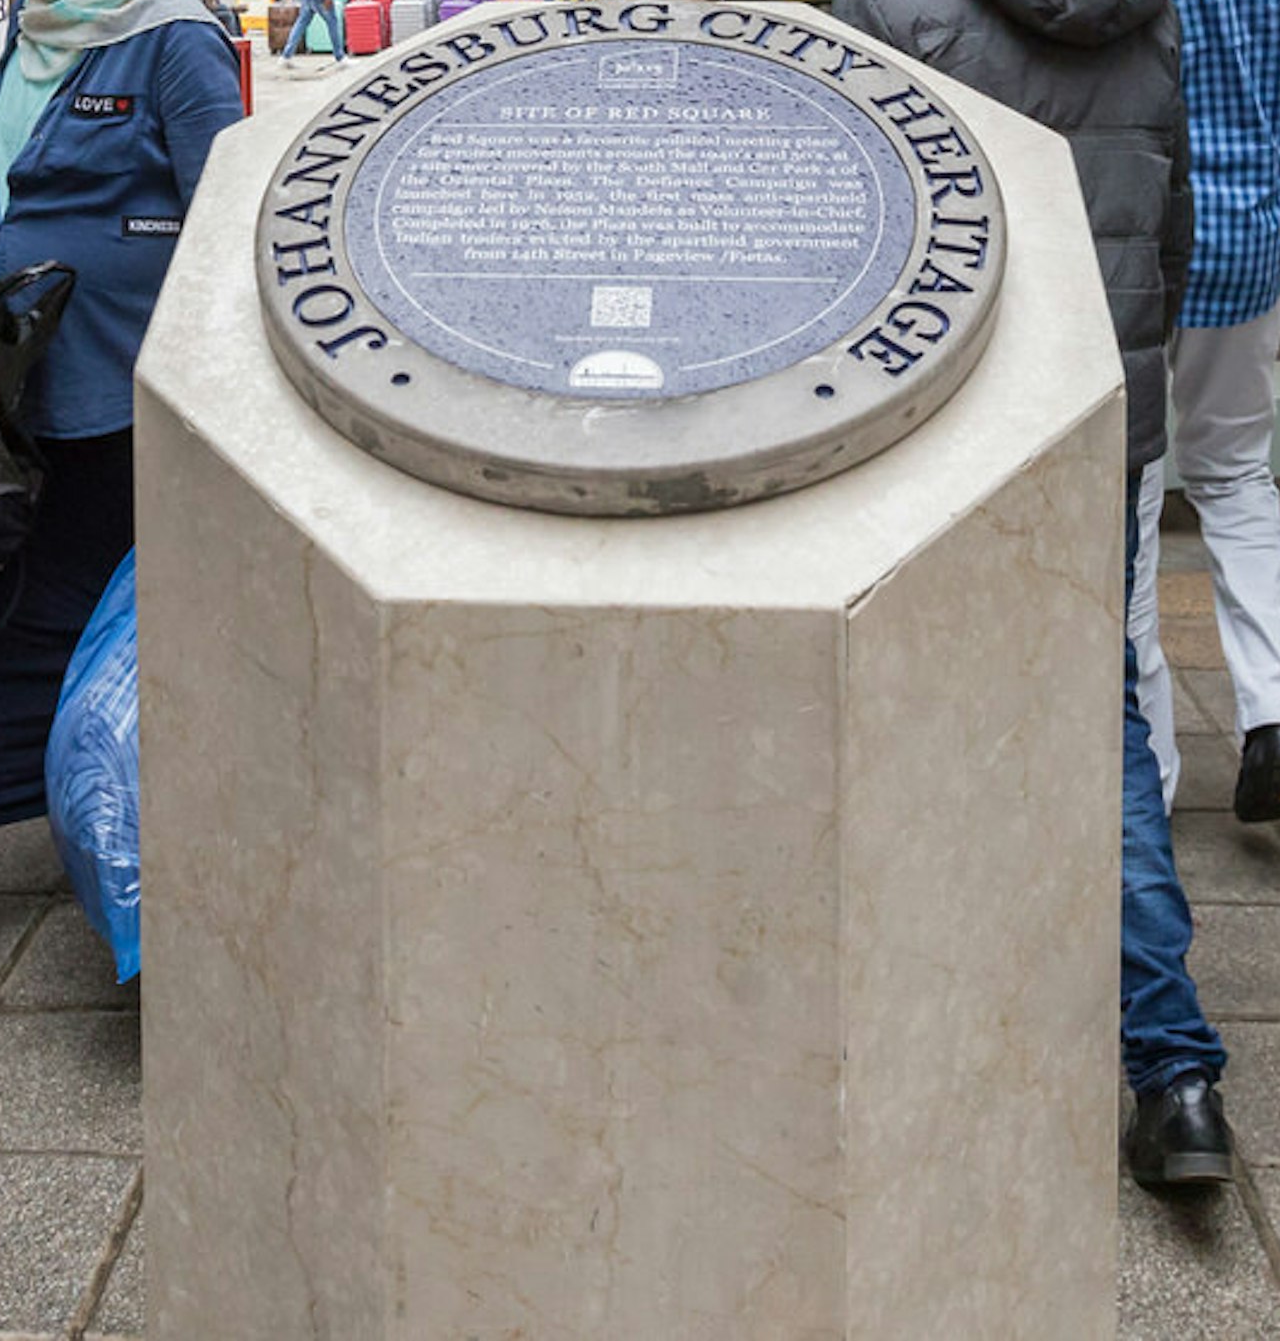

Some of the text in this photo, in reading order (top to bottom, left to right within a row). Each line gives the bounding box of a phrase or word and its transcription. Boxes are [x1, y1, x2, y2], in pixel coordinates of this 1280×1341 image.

[74, 96, 114, 112] LOVE
[499, 106, 771, 122] SITE OF RED SQUARE
[430, 134, 463, 144] Red
[467, 135, 524, 147] Square
[528, 137, 558, 145] was
[577, 135, 650, 145] favourite
[655, 136, 720, 148] political
[725, 136, 792, 148] meeting
[796, 137, 839, 149] place
[417, 148, 441, 158] for
[444, 148, 502, 160] protest
[506, 149, 600, 159] movements
[605, 149, 664, 159] around
[668, 150, 695, 160] the
[755, 150, 787, 160] and
[833, 151, 848, 161] at
[562, 162, 583, 174] by
[586, 162, 613, 172] the
[617, 163, 666, 173] South
[670, 163, 709, 173] Mall
[712, 163, 744, 173] and
[783, 164, 822, 174] Park
[840, 164, 859, 174] of
[400, 174, 428, 184] the
[439, 175, 514, 185] Oriental
[589, 176, 624, 186] The
[636, 176, 714, 186] Defiance
[725, 177, 817, 189] Campaign
[828, 180, 864, 188] was
[273, 2, 990, 379] JOHANNESBURG CITY HERITAGE
[395, 189, 471, 199] launched
[481, 190, 519, 200] here
[528, 190, 545, 200] in
[610, 191, 637, 201] the
[646, 191, 680, 201] first
[691, 194, 734, 202] mass
[743, 193, 867, 205] anti-apartheid
[391, 203, 475, 216] campaign
[478, 204, 505, 215] led
[509, 204, 531, 217] by
[535, 204, 593, 215] Nelson
[598, 205, 673, 216] Mandela
[677, 207, 696, 216] as
[392, 218, 487, 231] Completed
[490, 219, 507, 230] in
[559, 219, 588, 230] the
[593, 220, 637, 231] Plaza
[641, 222, 675, 231] was
[677, 221, 719, 232] built
[722, 221, 740, 232] to
[743, 222, 866, 233] accommodate
[396, 232, 859, 249] Indian traders evicted by the apartheid government
[463, 249, 507, 260] from
[553, 249, 606, 260] Street
[610, 250, 627, 261] in
[634, 250, 714, 263] Pageview
